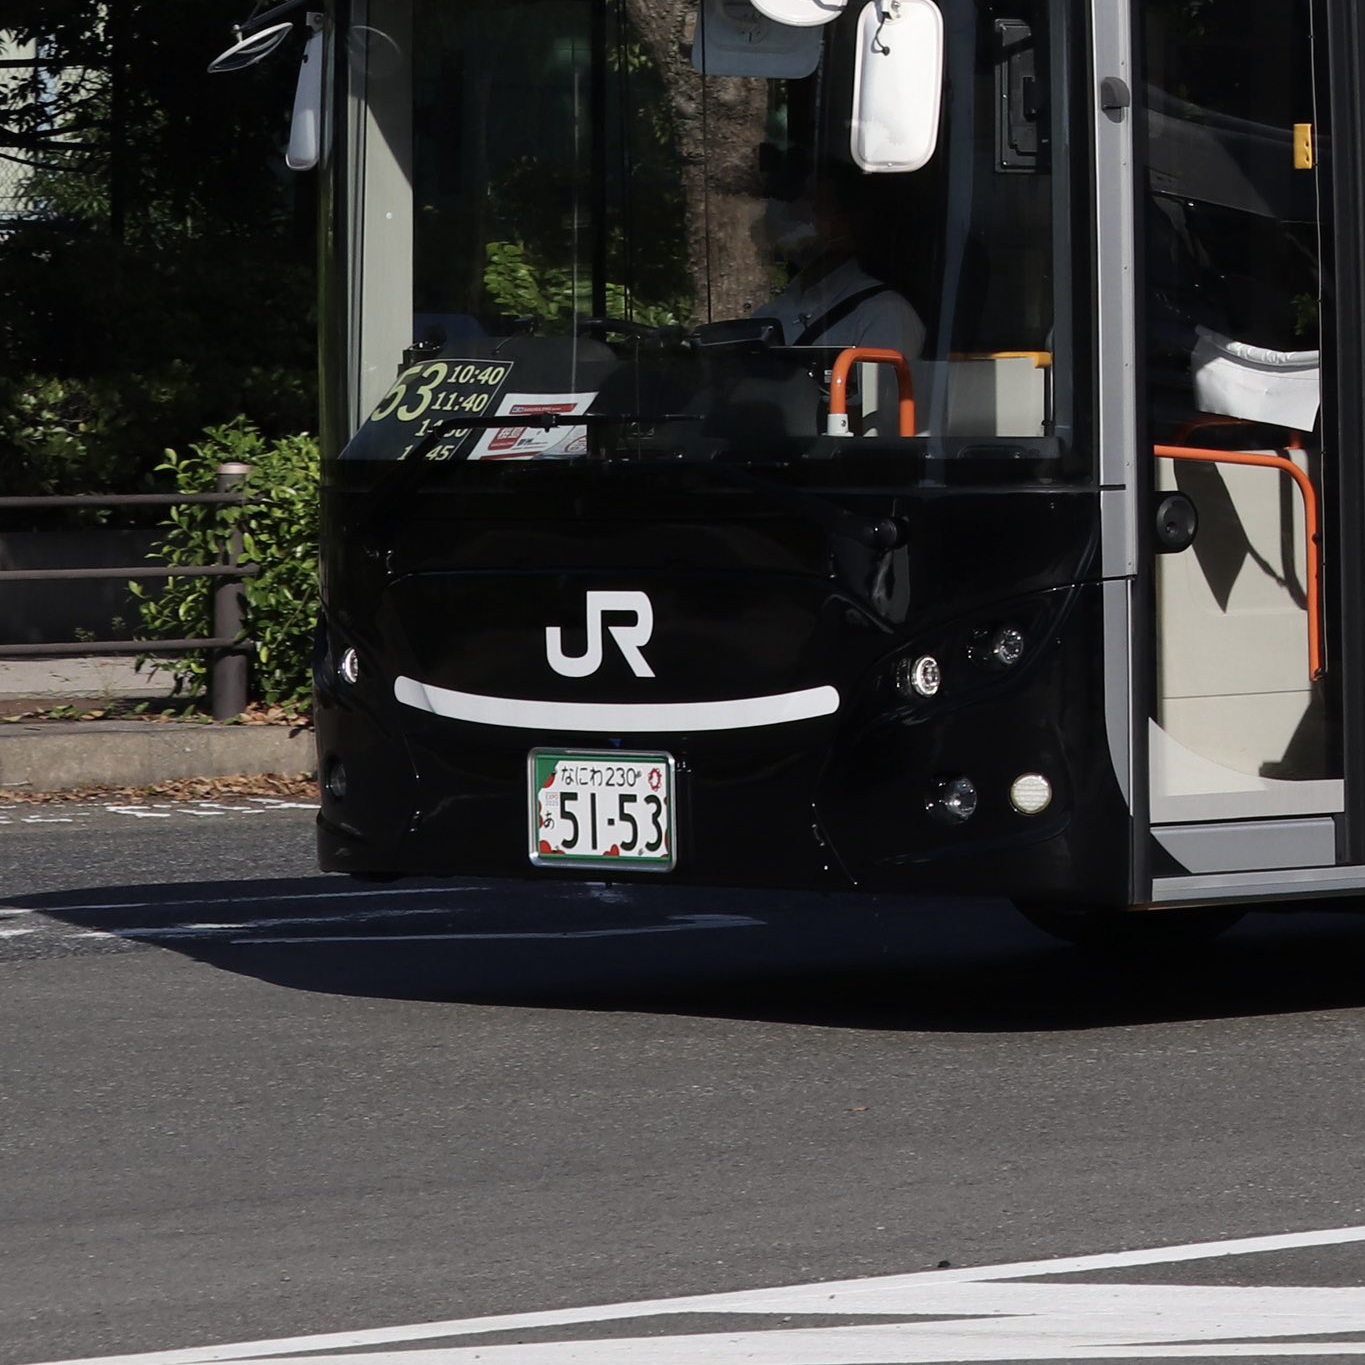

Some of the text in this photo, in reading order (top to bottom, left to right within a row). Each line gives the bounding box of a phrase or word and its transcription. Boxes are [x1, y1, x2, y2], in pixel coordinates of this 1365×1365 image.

[371, 362, 448, 422] 53
[430, 391, 489, 412] 11:40
[447, 365, 505, 385] 10:40
[545, 590, 656, 677] JR
[543, 791, 663, 853] あ 51-53
